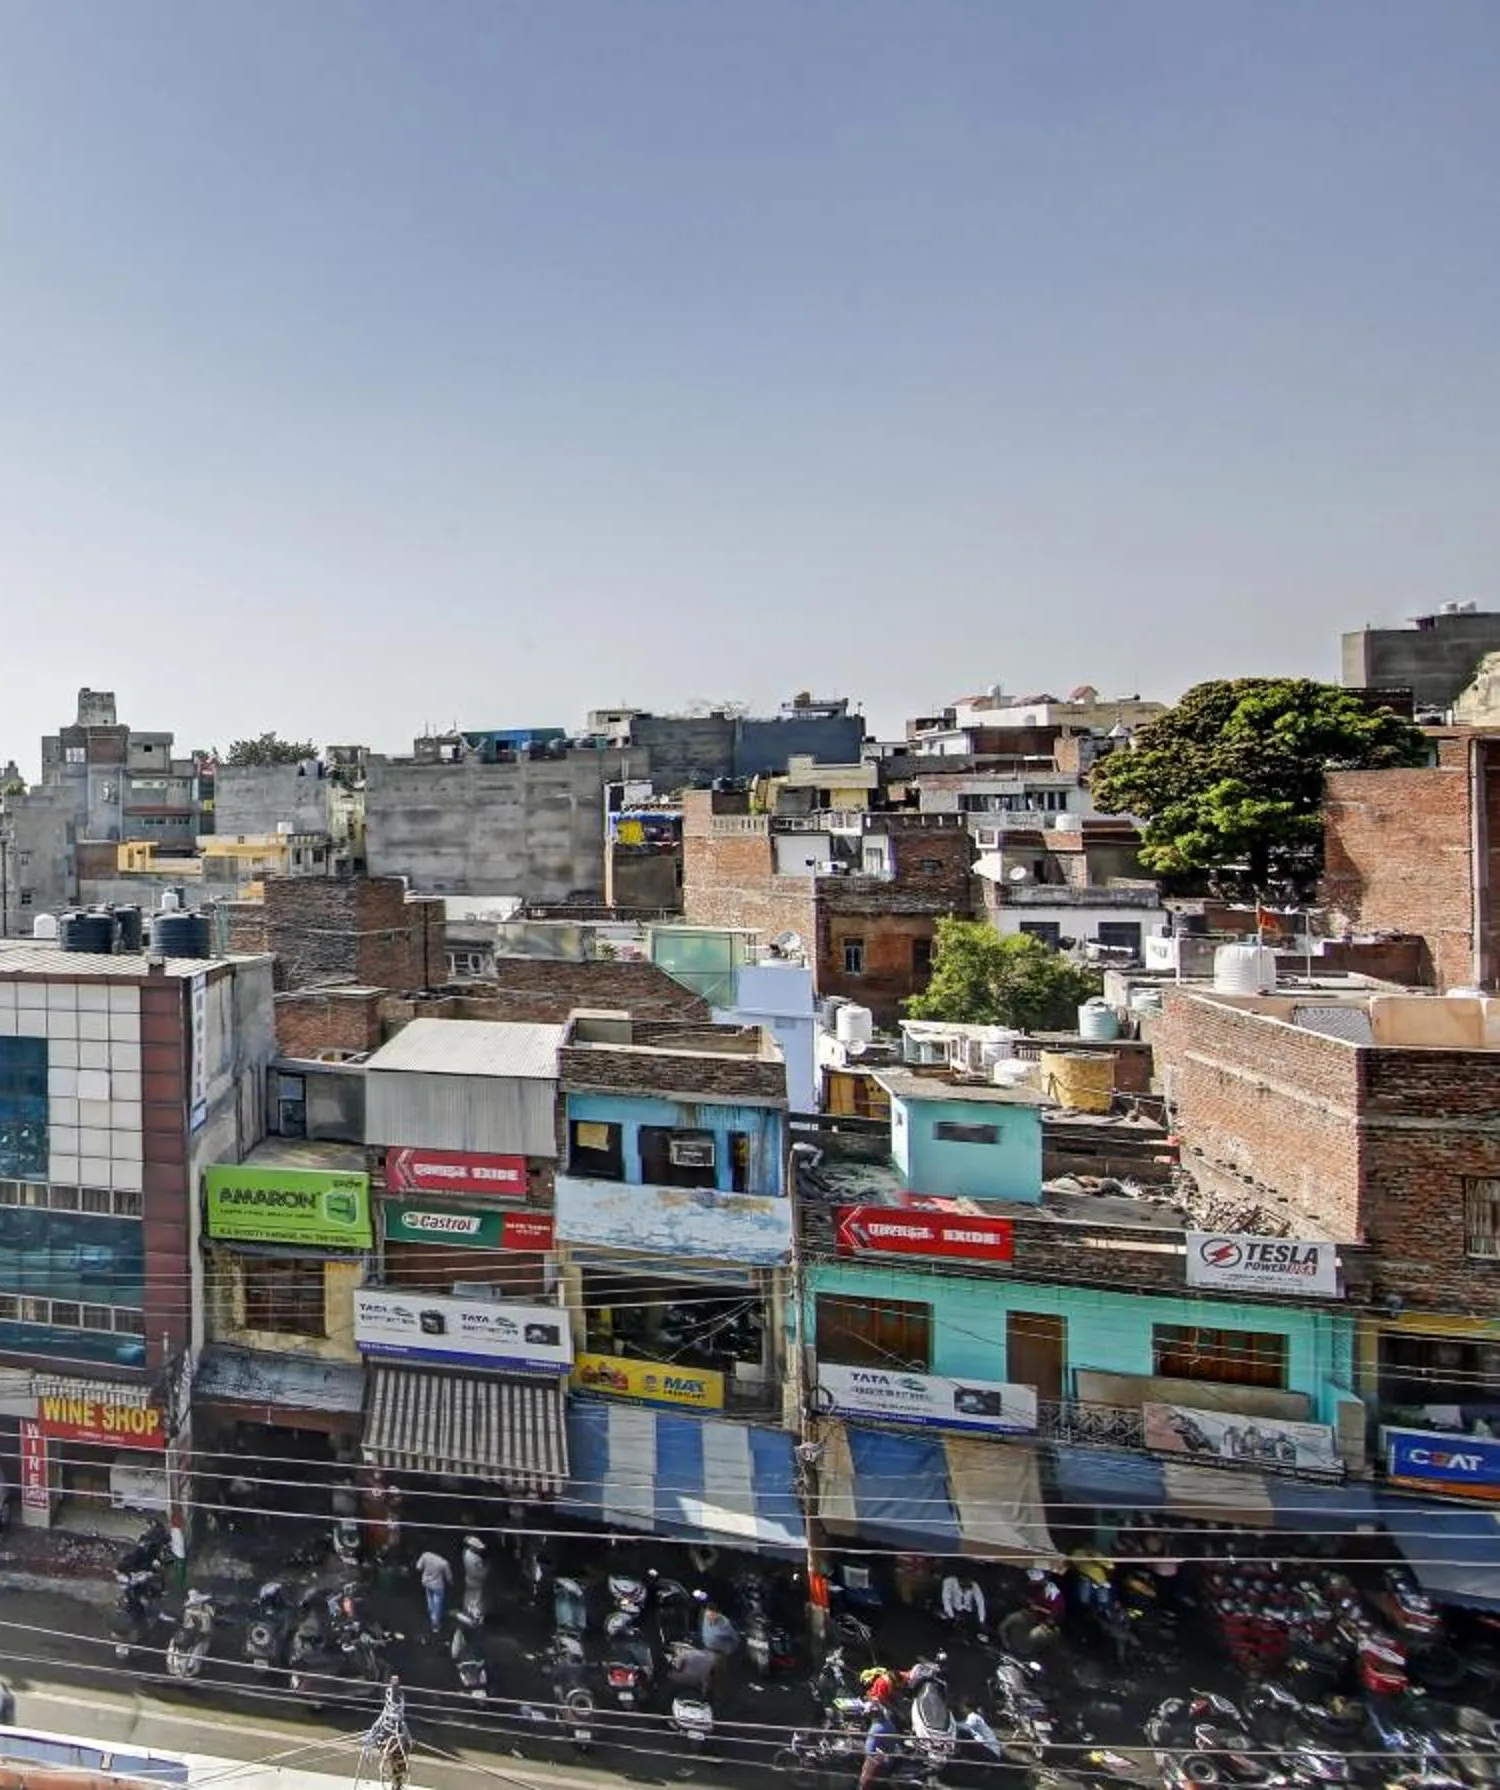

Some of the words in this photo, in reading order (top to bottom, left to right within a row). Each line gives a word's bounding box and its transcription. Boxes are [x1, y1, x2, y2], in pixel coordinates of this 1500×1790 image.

[220, 1187, 318, 1209] AMARON
[420, 1215, 473, 1232] Castrol
[943, 1229, 1001, 1245] EXIDE
[1246, 1243, 1319, 1265] TESLA
[460, 1313, 490, 1324] TATA
[850, 1372, 891, 1385] TATA
[42, 1397, 95, 1427] WINE
[102, 1405, 158, 1435] SHOP
[26, 1423, 40, 1487] WINE
[1410, 1449, 1484, 1471] CEAT
